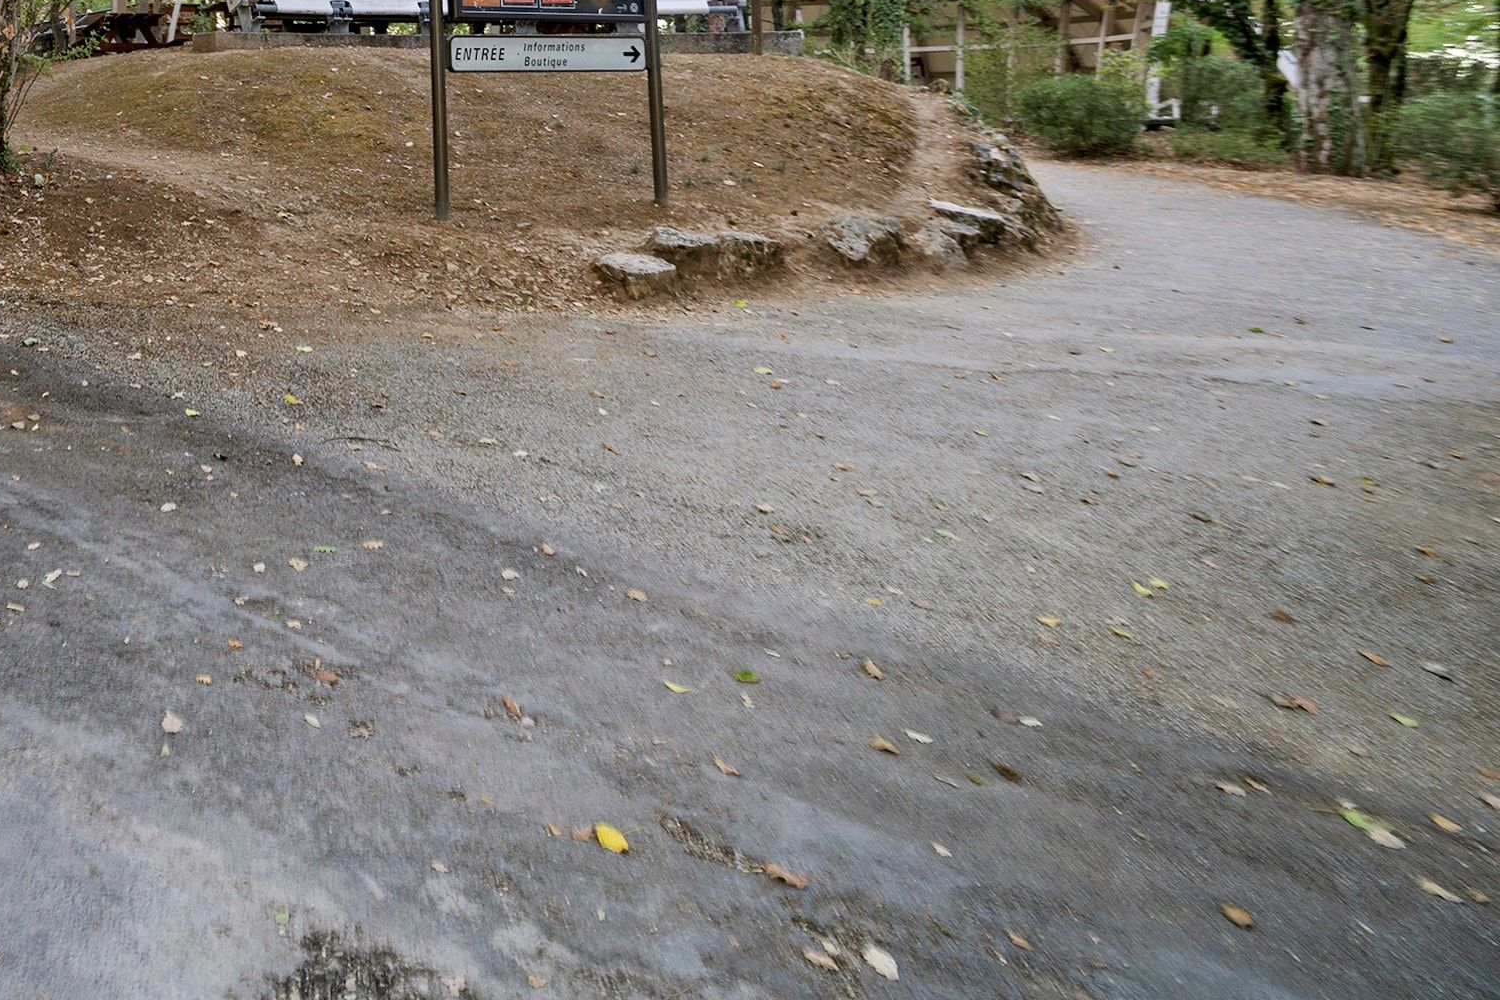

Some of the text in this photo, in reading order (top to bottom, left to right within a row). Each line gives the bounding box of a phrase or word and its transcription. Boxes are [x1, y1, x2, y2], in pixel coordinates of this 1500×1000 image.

[455, 45, 505, 61] ENTRÉE
[523, 42, 586, 52] Informations
[524, 56, 568, 68] Boutique
